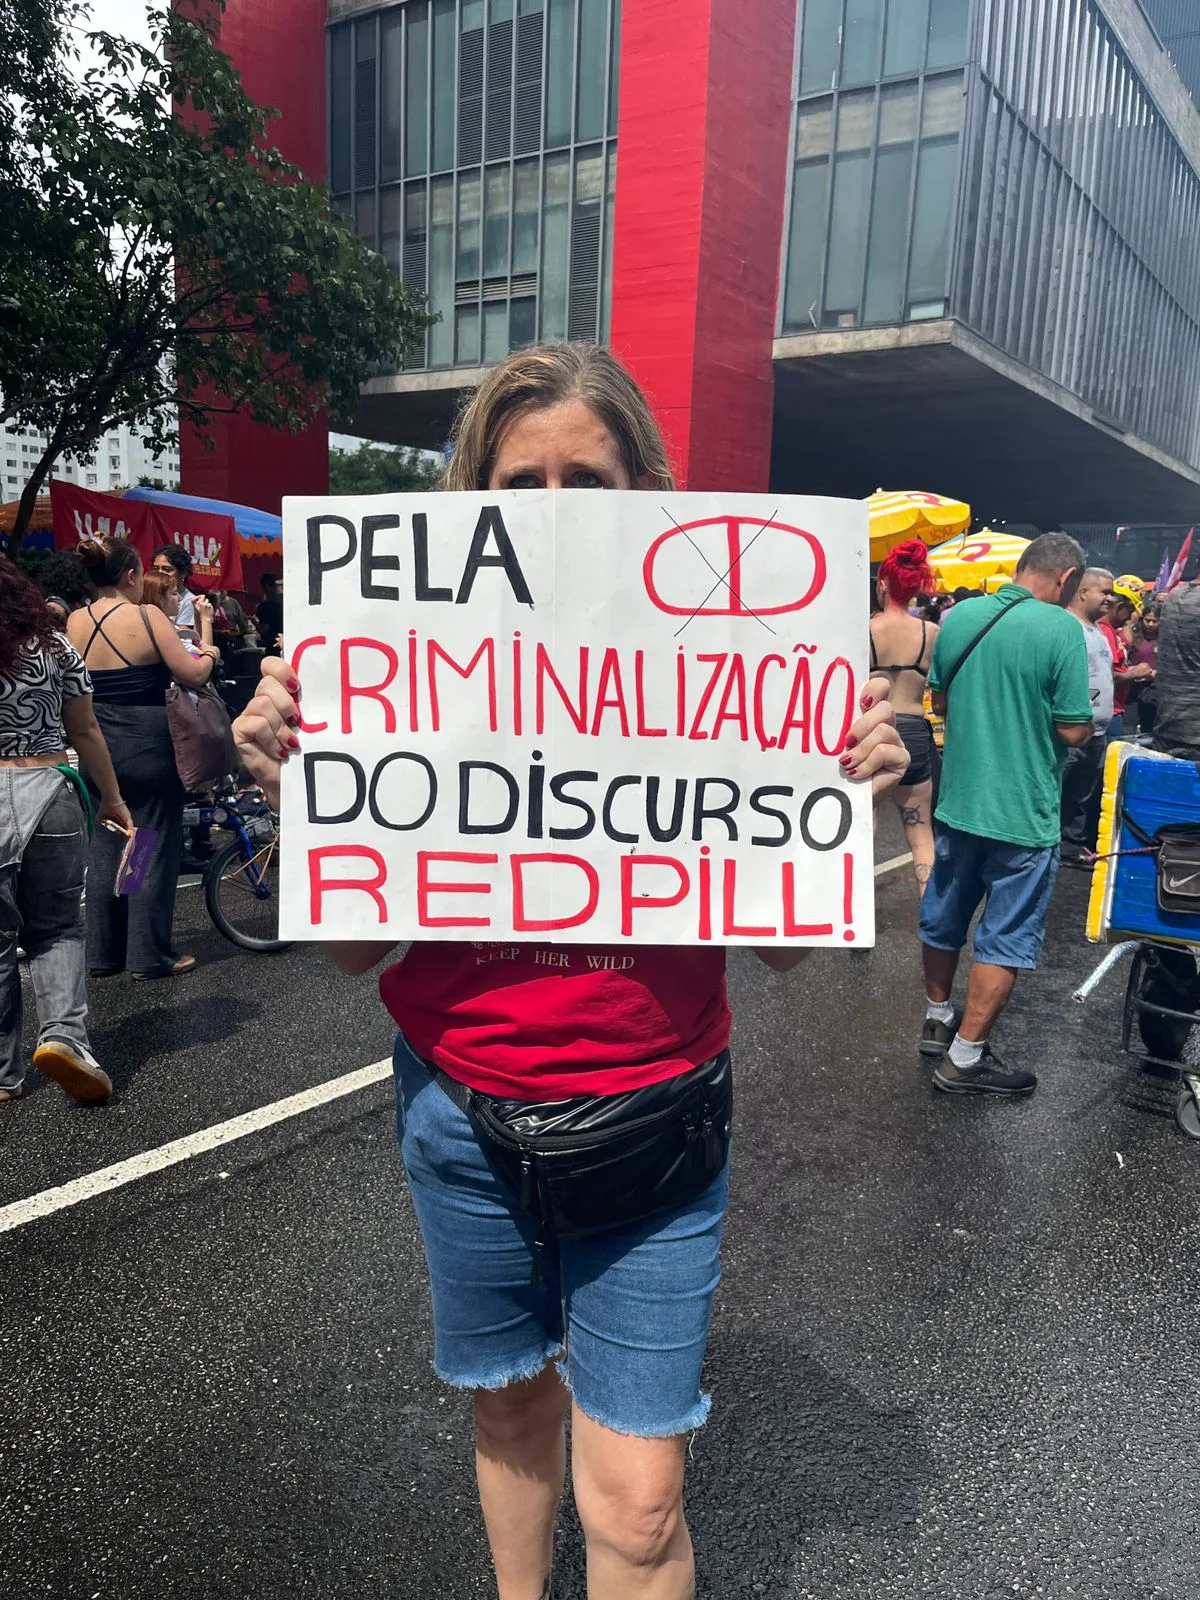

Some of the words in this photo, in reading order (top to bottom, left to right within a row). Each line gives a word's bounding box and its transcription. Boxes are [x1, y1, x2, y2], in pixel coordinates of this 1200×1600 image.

[306, 505, 535, 609] PELA
[290, 629, 856, 756] CRIMINALIZAÇÃO
[303, 751, 438, 831] DO
[458, 750, 853, 852] DISCURSO
[476, 947, 520, 966] KEEP
[535, 950, 571, 968] HER
[585, 954, 635, 970] WILD
